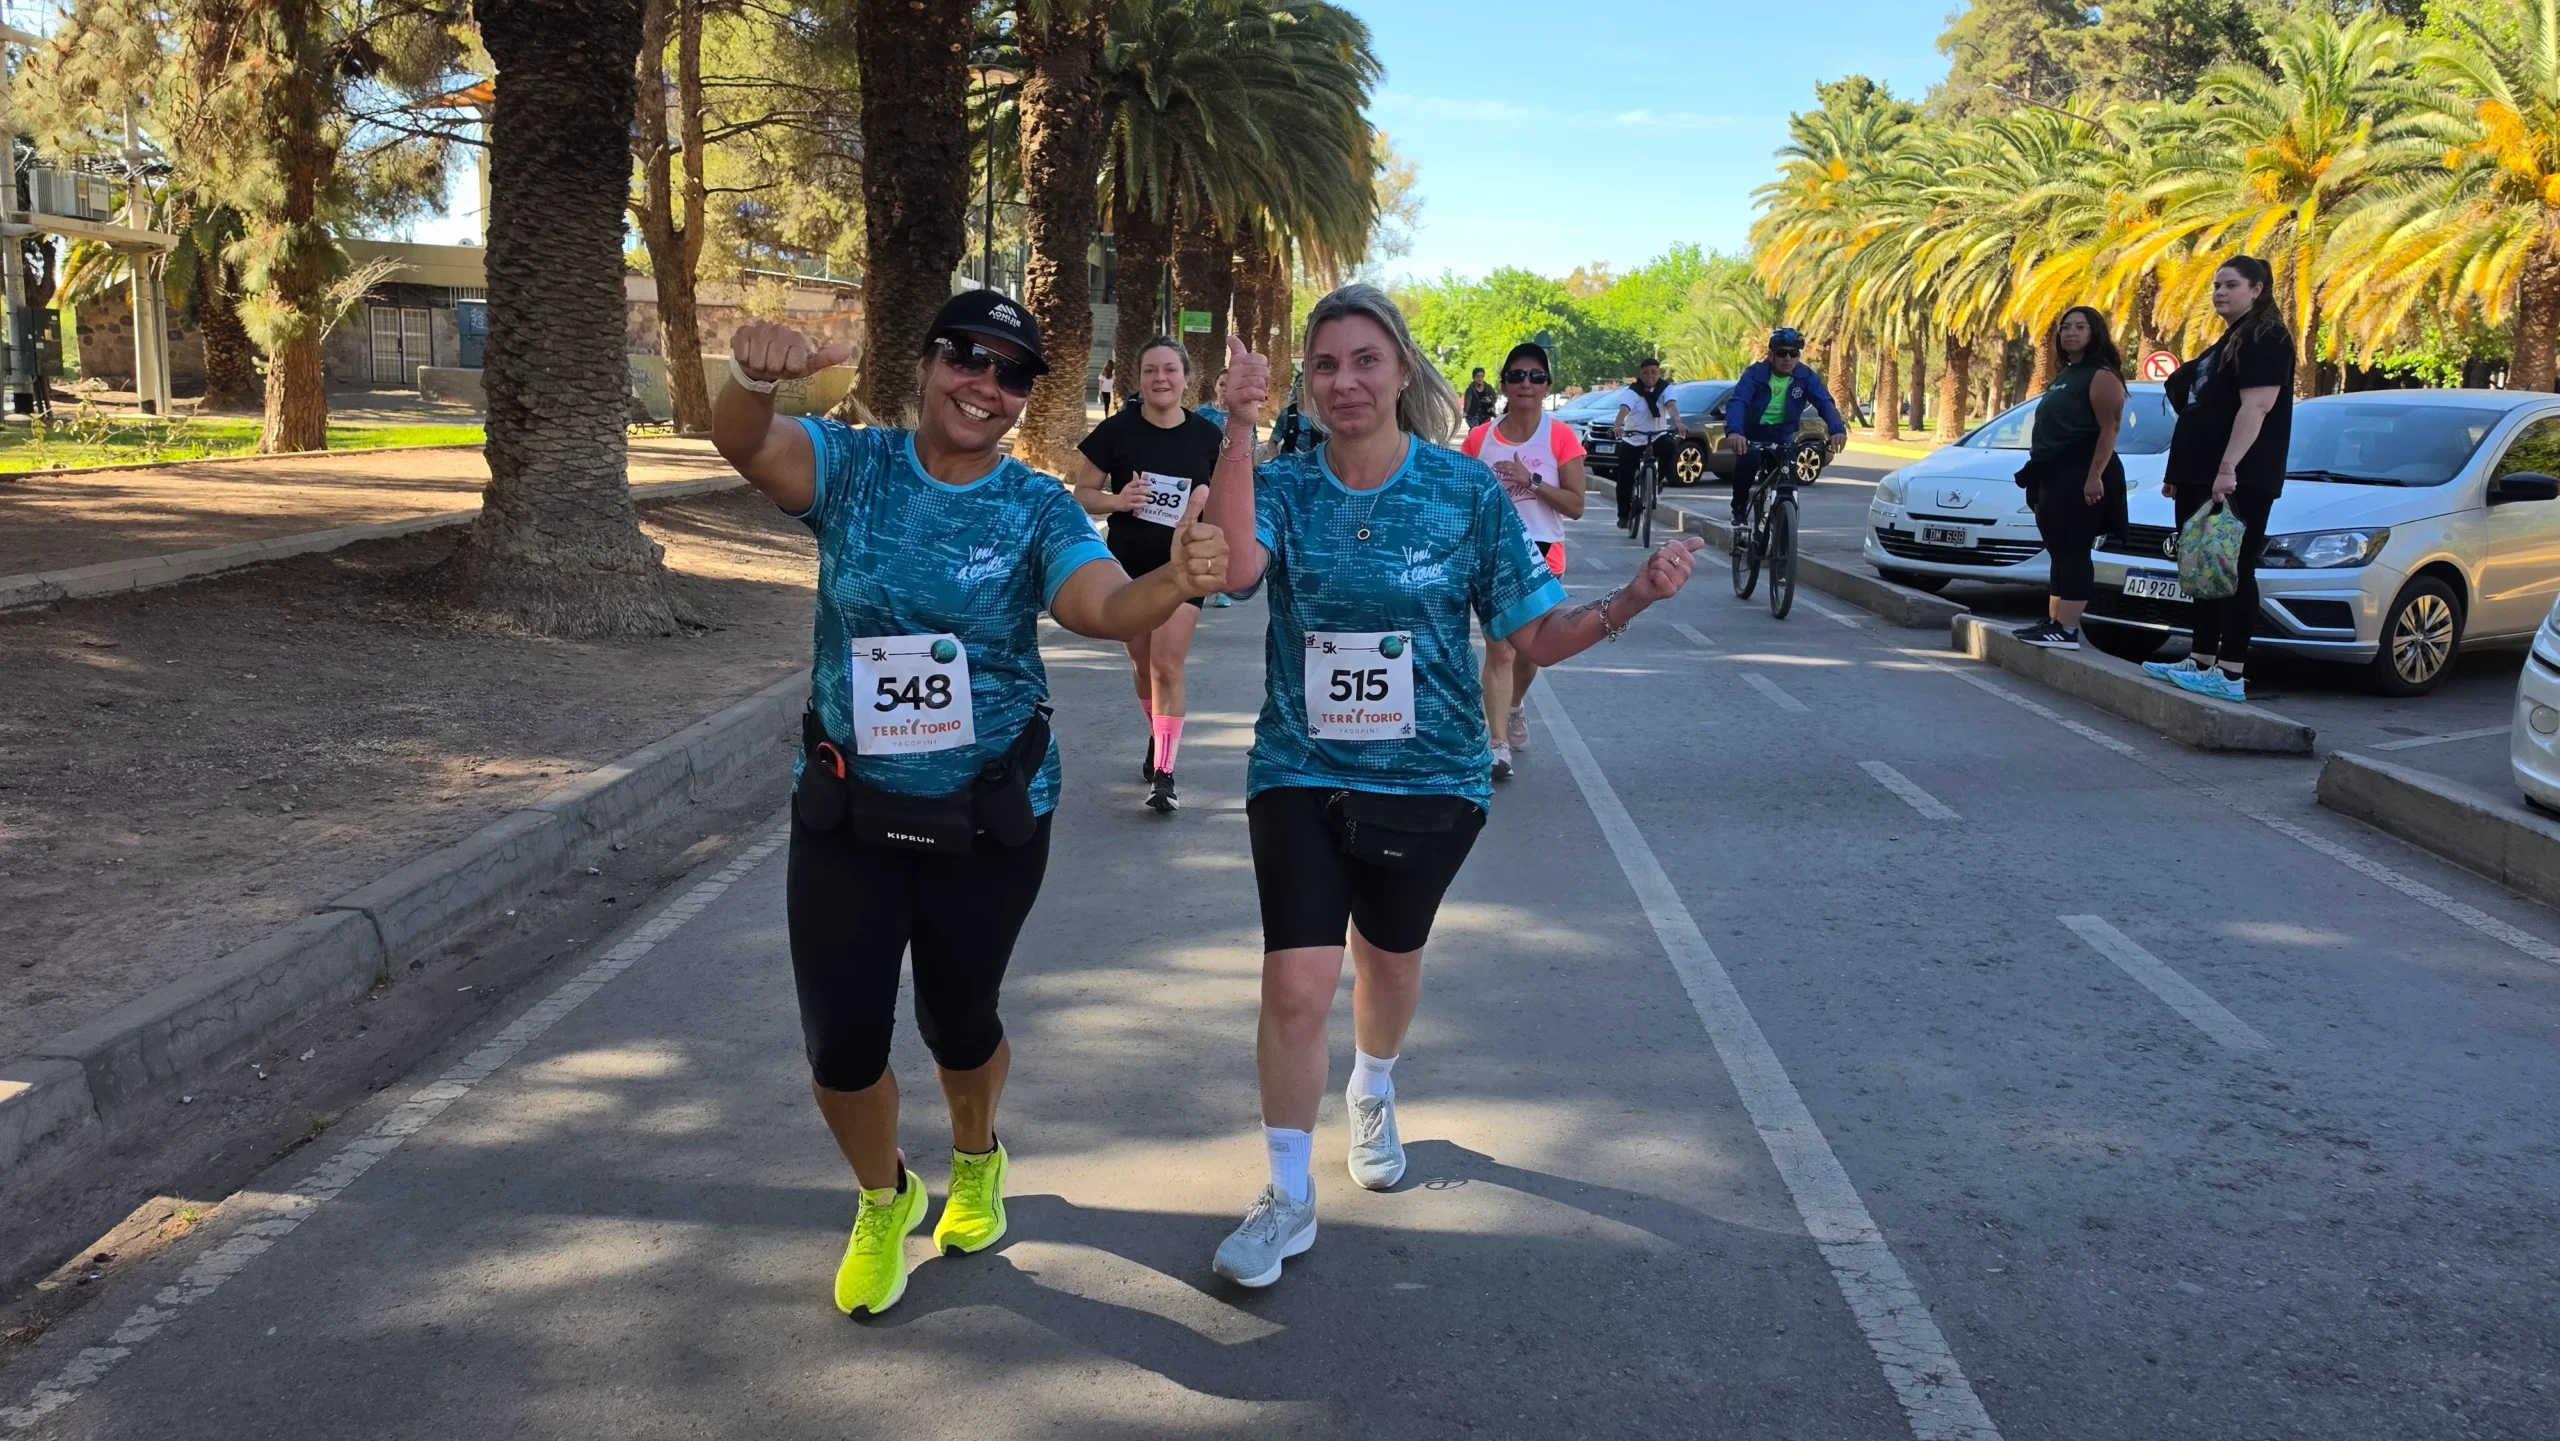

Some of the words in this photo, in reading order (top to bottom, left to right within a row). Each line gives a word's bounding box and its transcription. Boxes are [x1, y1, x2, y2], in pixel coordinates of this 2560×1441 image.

[1946, 531, 1964, 543] 698
[2127, 579, 2146, 593] AD
[2150, 581, 2176, 597] 920
[871, 647, 888, 661] 5k
[1322, 641, 1337, 654] 5k
[1328, 668, 1389, 702] 515
[873, 674, 953, 712] 548
[1321, 708, 1403, 723] TERRITORIO
[872, 718, 961, 737] TERRITORIO
[887, 832, 935, 844] KIPRUN
